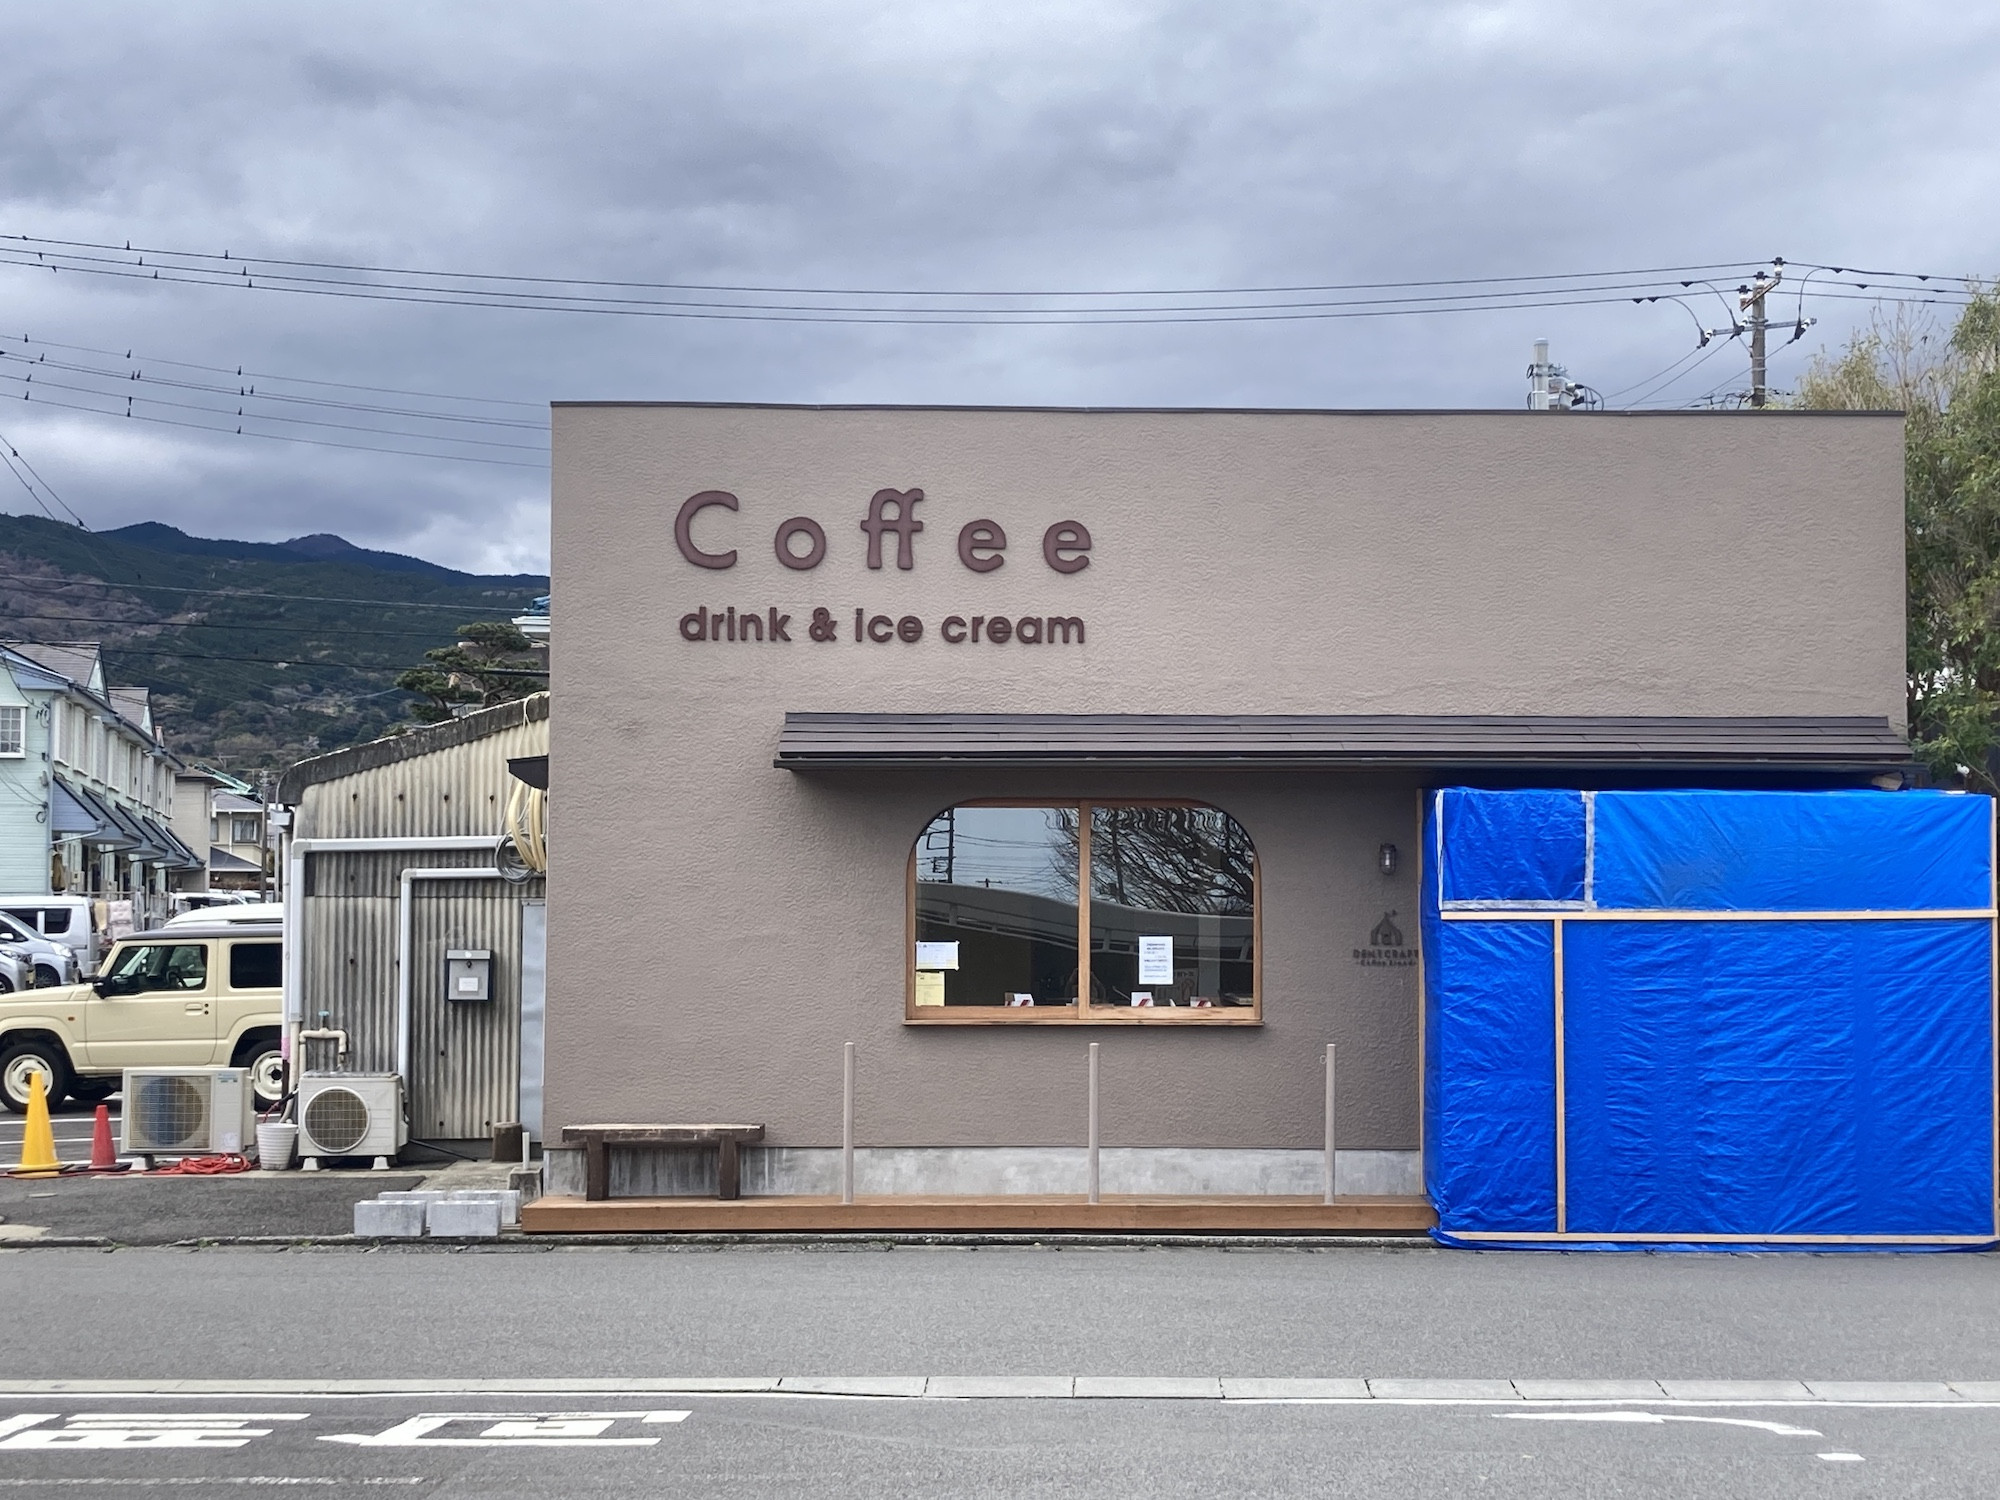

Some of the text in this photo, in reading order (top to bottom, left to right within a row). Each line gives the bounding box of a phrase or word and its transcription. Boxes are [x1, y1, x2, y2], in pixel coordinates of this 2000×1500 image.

[674, 487, 1092, 575] Coffee
[679, 606, 1085, 644] drink & ice cream
